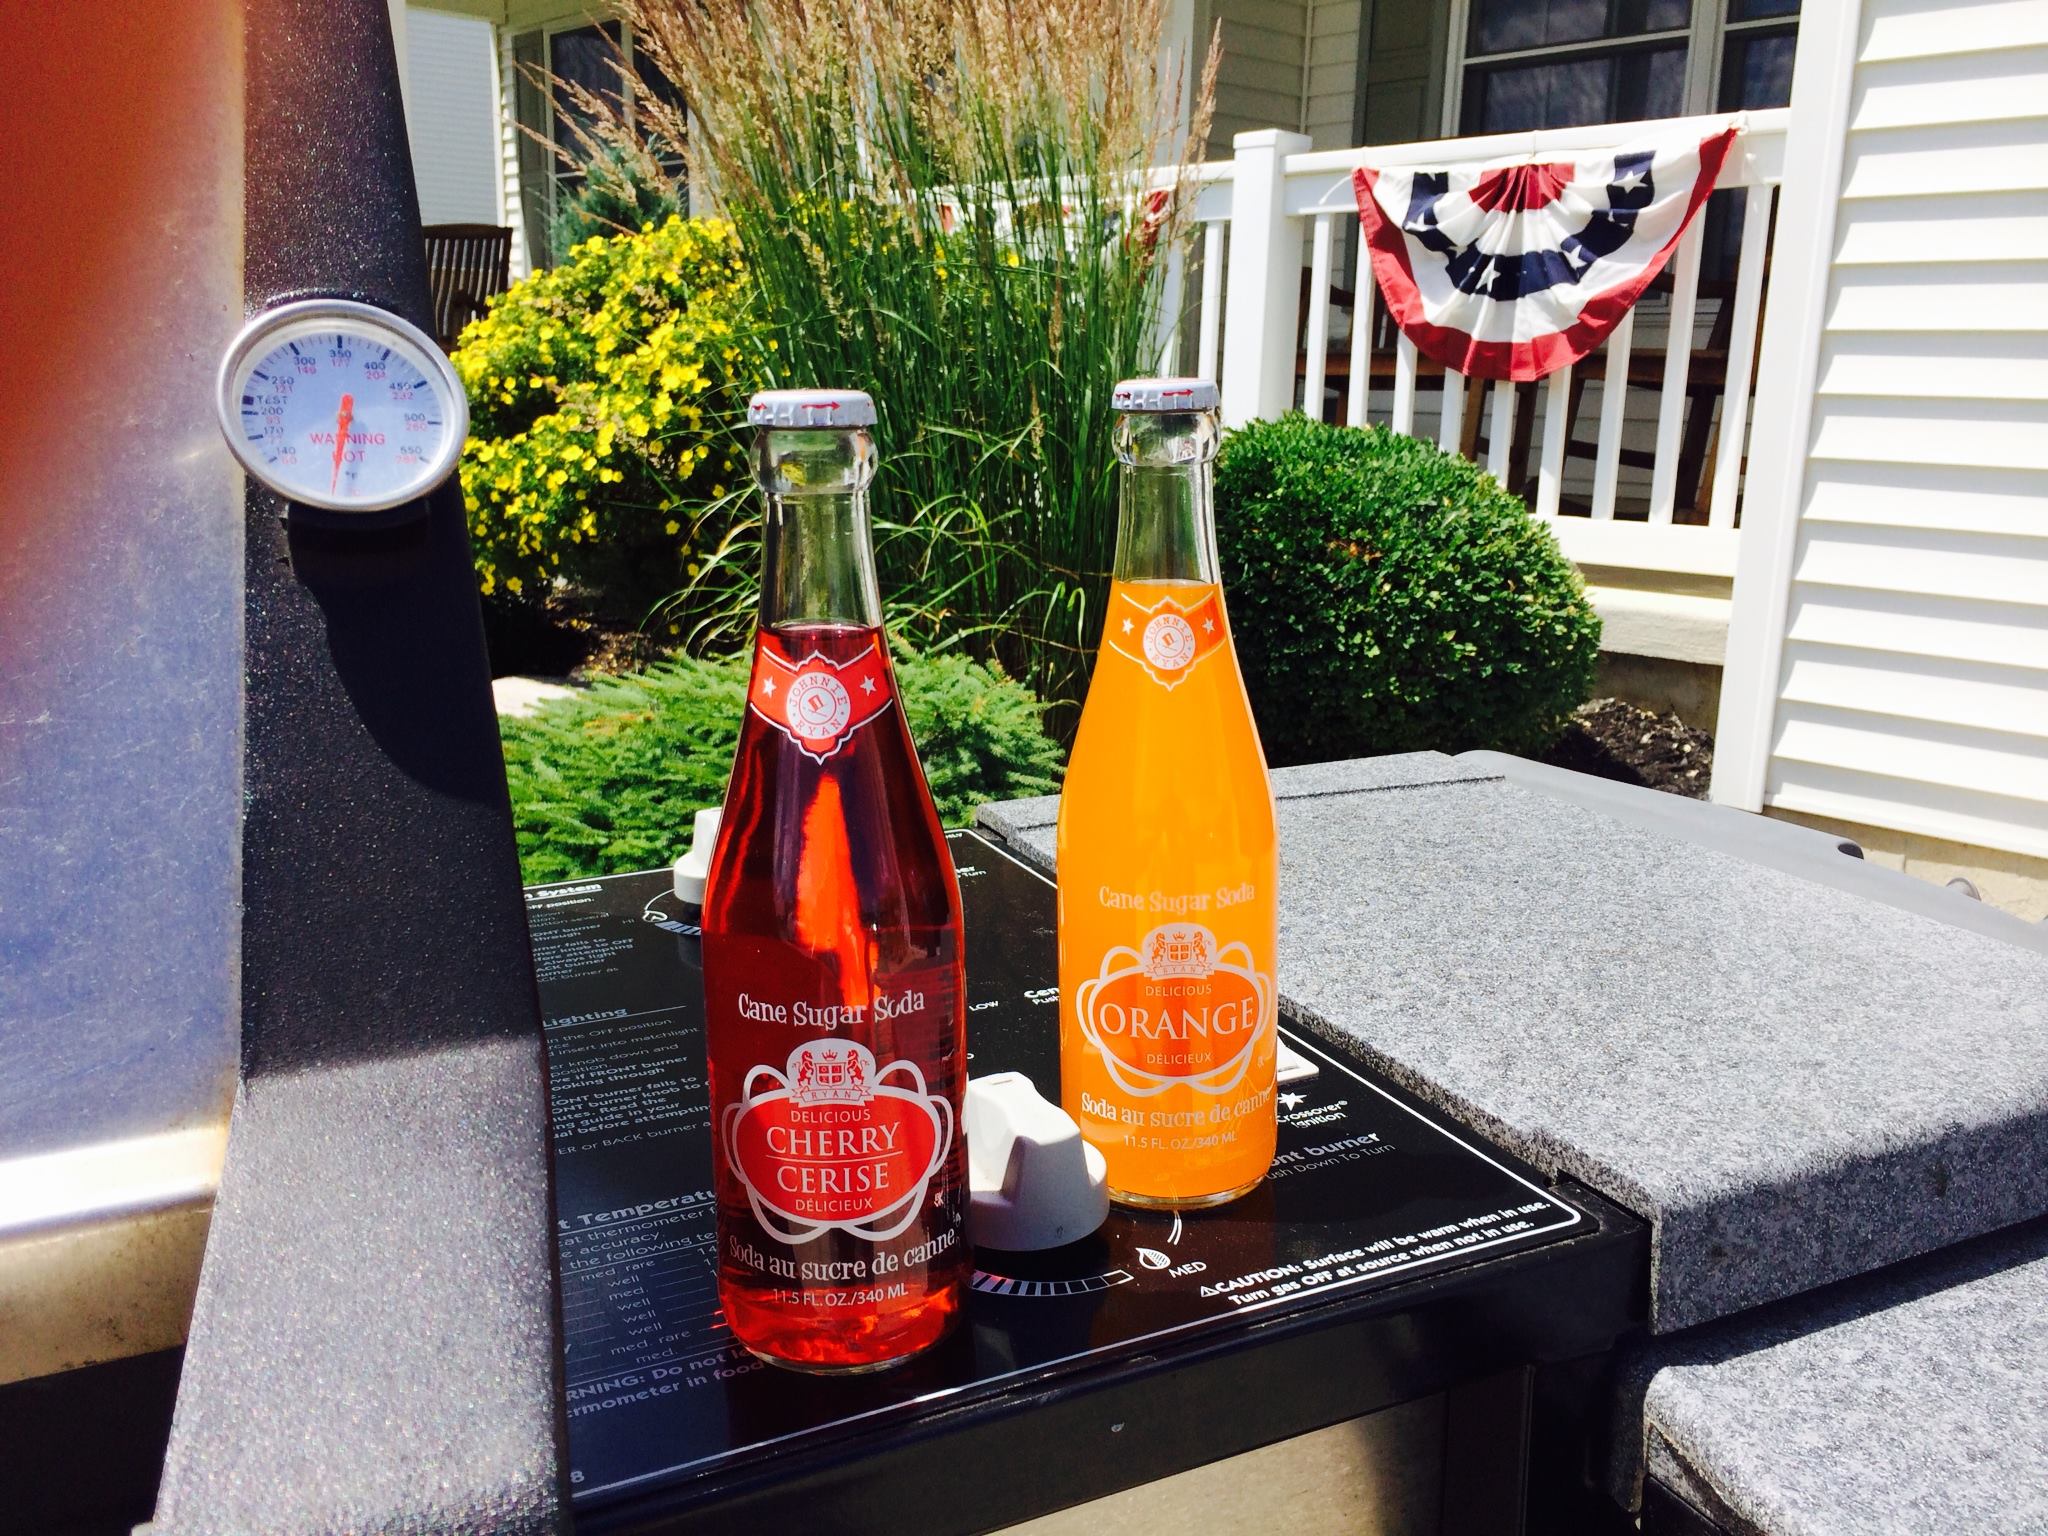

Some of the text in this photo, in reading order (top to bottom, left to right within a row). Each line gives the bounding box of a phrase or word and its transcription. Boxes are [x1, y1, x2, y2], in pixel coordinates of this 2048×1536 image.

[293, 357, 316, 366] 300
[329, 349, 352, 358] 350
[364, 361, 386, 371] 400
[310, 433, 386, 445] WANING
[789, 675, 848, 708] JOHNNIE
[795, 718, 843, 736] RYAN
[1099, 882, 1256, 915] Cane Sugar Soda
[1023, 987, 1059, 998] Cen
[1144, 983, 1213, 998] DELICIOUS
[738, 989, 926, 1031] Cane Sugar Soda
[969, 1000, 999, 1012] LOW
[1099, 996, 1254, 1040] ORANGE
[559, 1043, 597, 1056] insert
[601, 1040, 627, 1049] into
[563, 1032, 585, 1041] the
[569, 1055, 605, 1068] knob
[609, 1048, 650, 1061] down
[654, 1042, 679, 1052] and
[590, 1064, 637, 1079] FRONT
[641, 1055, 688, 1069] burner
[551, 1077, 604, 1092] ooking
[608, 1066, 665, 1083] through
[594, 1086, 643, 1100] burner
[647, 1079, 678, 1091] fails
[681, 1075, 697, 1084] to
[552, 1103, 584, 1115] ONT
[589, 1094, 638, 1108] burner
[642, 1085, 681, 1099] knob
[685, 1082, 701, 1091] to
[600, 1097, 668, 1115] Read the
[811, 1089, 852, 1100] RYAN
[580, 1101, 681, 1126] guide in your
[790, 1108, 871, 1124] DELICIOUS
[1081, 1092, 1117, 1121] Soda
[1121, 1107, 1145, 1127] au
[1150, 1109, 1206, 1128] sucre
[1209, 1103, 1231, 1124] de
[1290, 1111, 1347, 1129] Ignition
[578, 1118, 630, 1135] before
[558, 1145, 577, 1155] ER
[581, 1141, 599, 1151] or
[602, 1132, 643, 1147] BACK
[647, 1122, 698, 1139] burner
[766, 1121, 900, 1157] CHERRY
[1123, 1134, 1148, 1150] 11.5
[1220, 1132, 1238, 1145] ML
[1270, 1132, 1381, 1167] ont burner
[1266, 1142, 1397, 1181] ush Down To Turn
[776, 1162, 890, 1194] CERISE
[577, 1189, 716, 1226] Temperatu
[587, 1209, 705, 1242] thermometer
[570, 1257, 601, 1270] the
[606, 1236, 693, 1263] following
[729, 1235, 765, 1272] Soda
[769, 1255, 797, 1280] au
[801, 1260, 867, 1281] sucre
[871, 1250, 899, 1276] de
[903, 1227, 955, 1268] canne
[1214, 1201, 1551, 1293] CAUTION: Surface will be warm when in use.
[626, 1258, 656, 1273] rare
[1168, 1261, 1207, 1279] MED
[1227, 1220, 1535, 1306] Turn gas OFF at source when not in use.
[607, 1274, 640, 1288] well
[617, 1297, 651, 1312] well
[772, 1288, 800, 1305] 11.5
[887, 1282, 909, 1300] ML
[623, 1309, 657, 1324] well
[628, 1321, 663, 1337] well
[658, 1329, 692, 1344] rare
[566, 1374, 646, 1402] RNING:
[652, 1365, 683, 1380] Do
[689, 1352, 727, 1371] not
[687, 1375, 708, 1388] in
[713, 1359, 765, 1381] food
